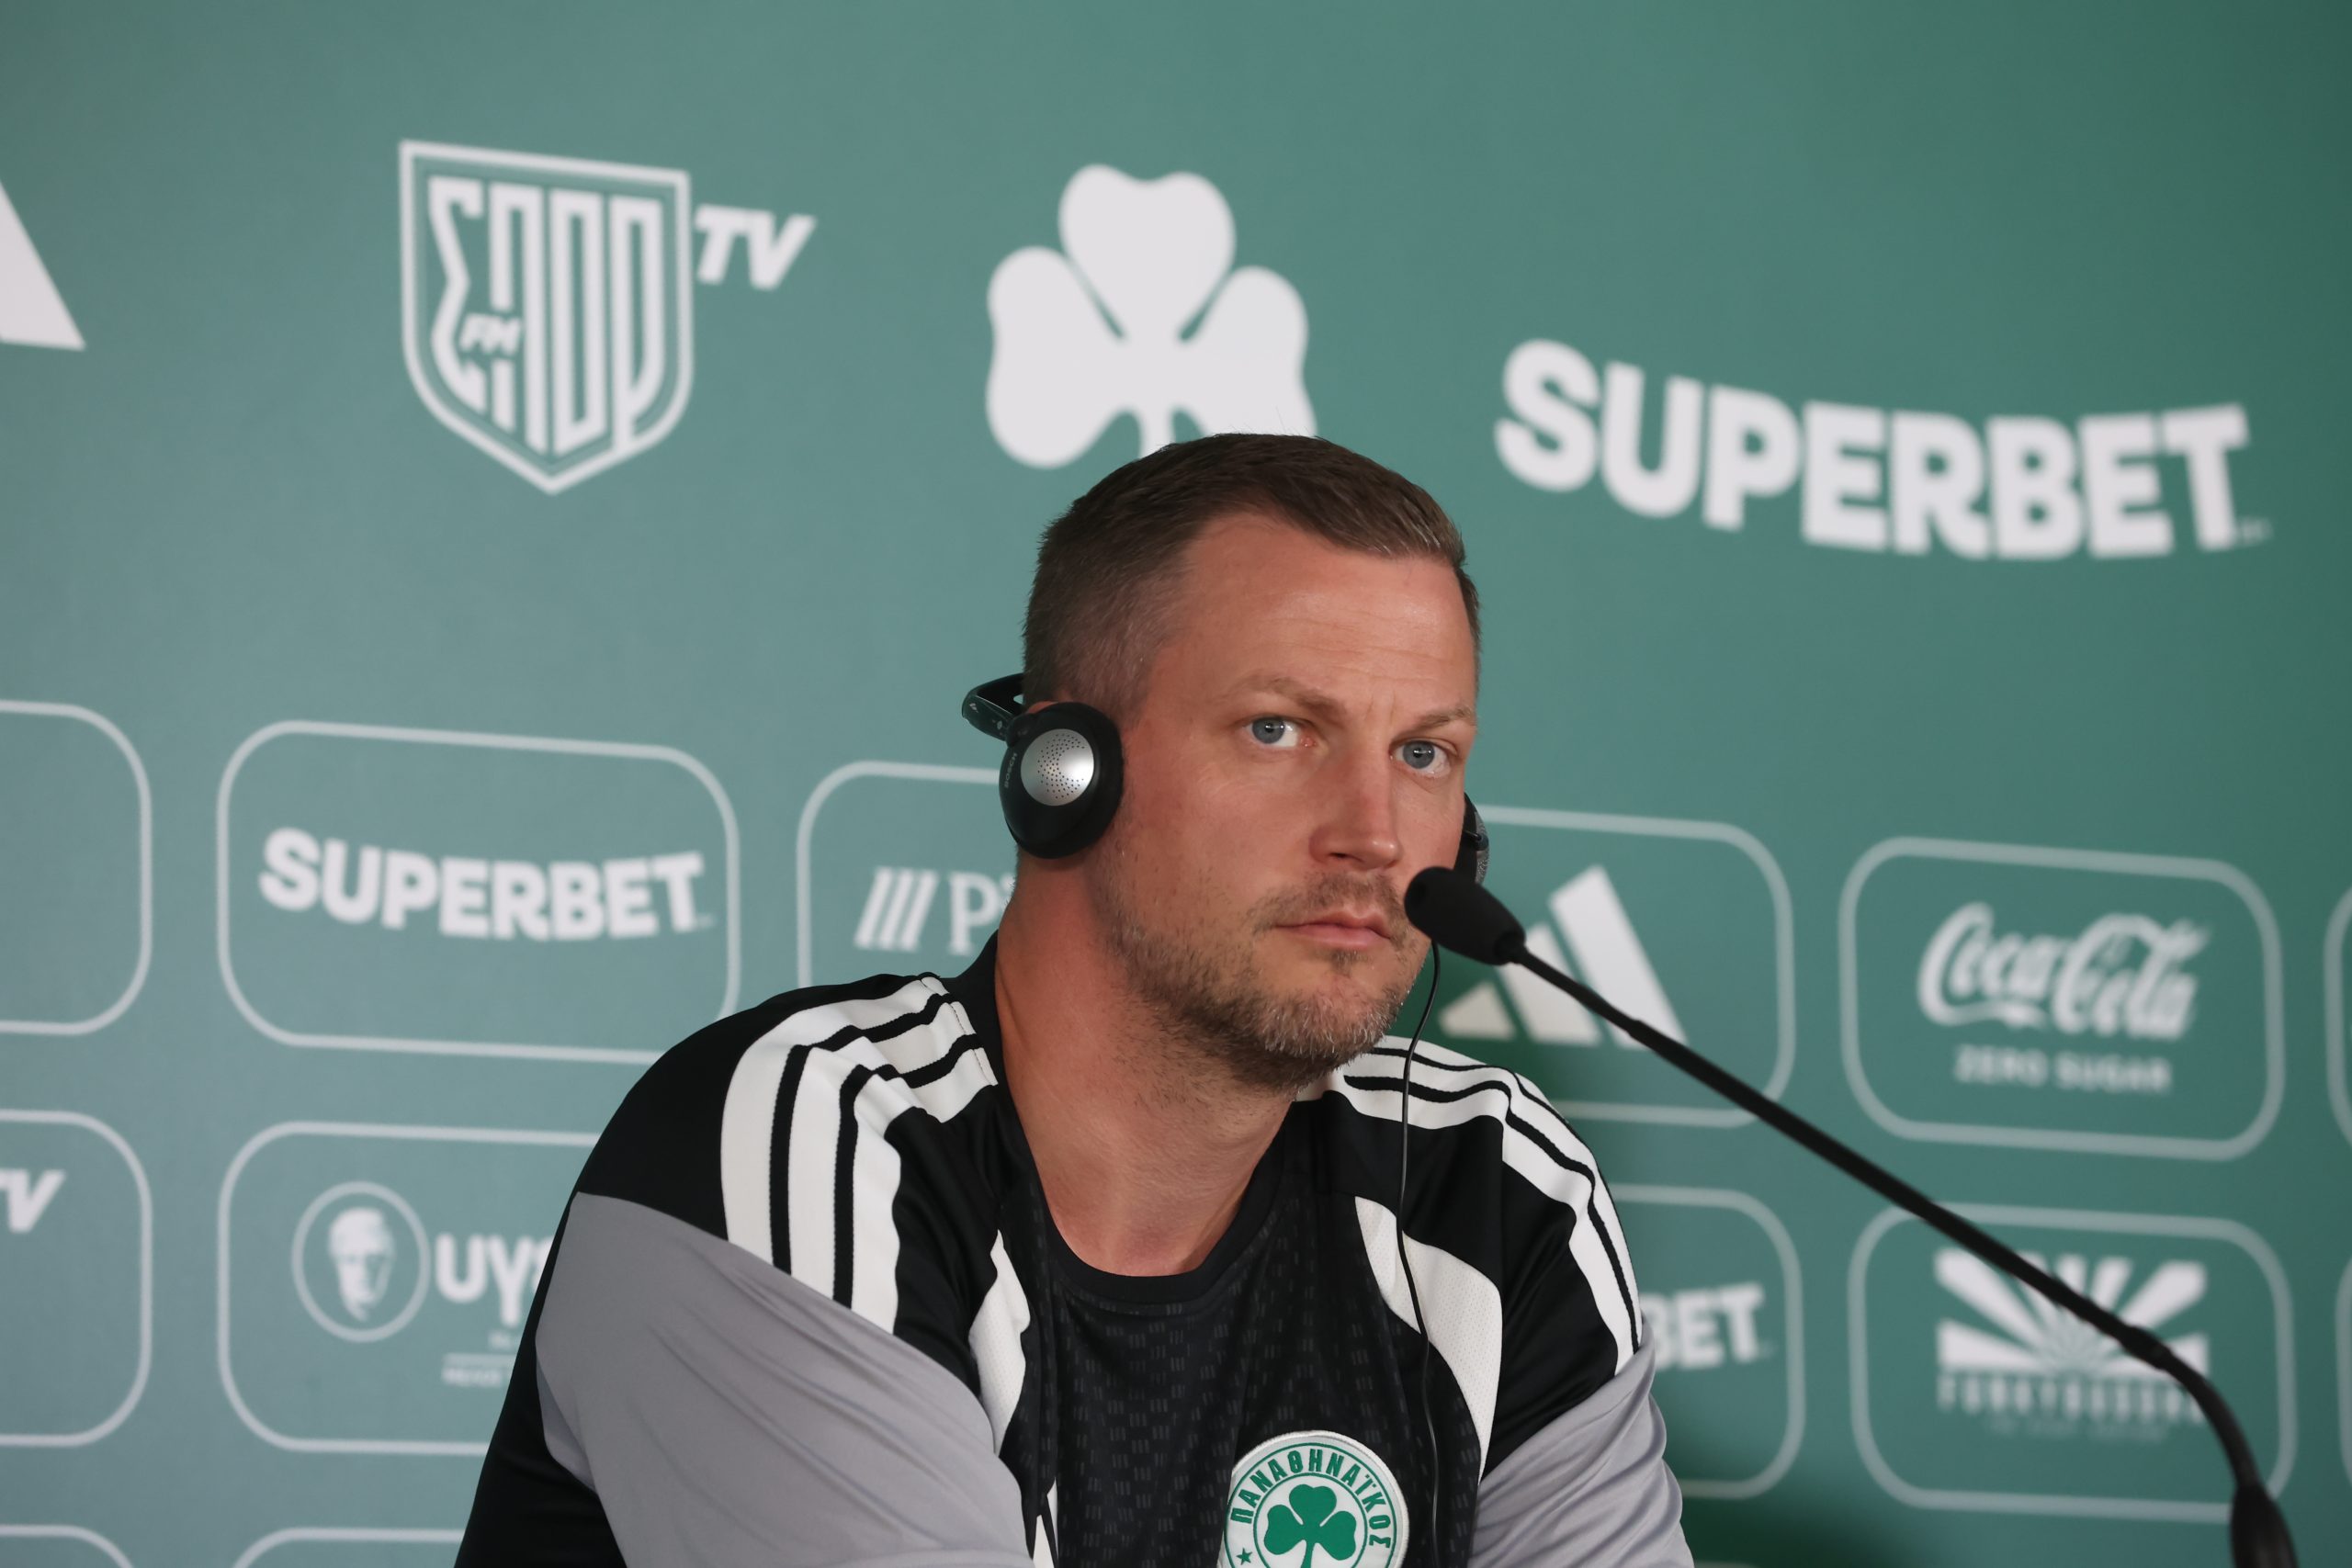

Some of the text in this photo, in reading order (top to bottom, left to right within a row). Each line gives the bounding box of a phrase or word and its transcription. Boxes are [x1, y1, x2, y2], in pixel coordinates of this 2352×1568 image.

[694, 203, 816, 290] TV
[1494, 338, 2251, 559] SUPERBET
[259, 826, 706, 942] SUPERBET
[1953, 1044, 2174, 1093] ZERO SUGAR
